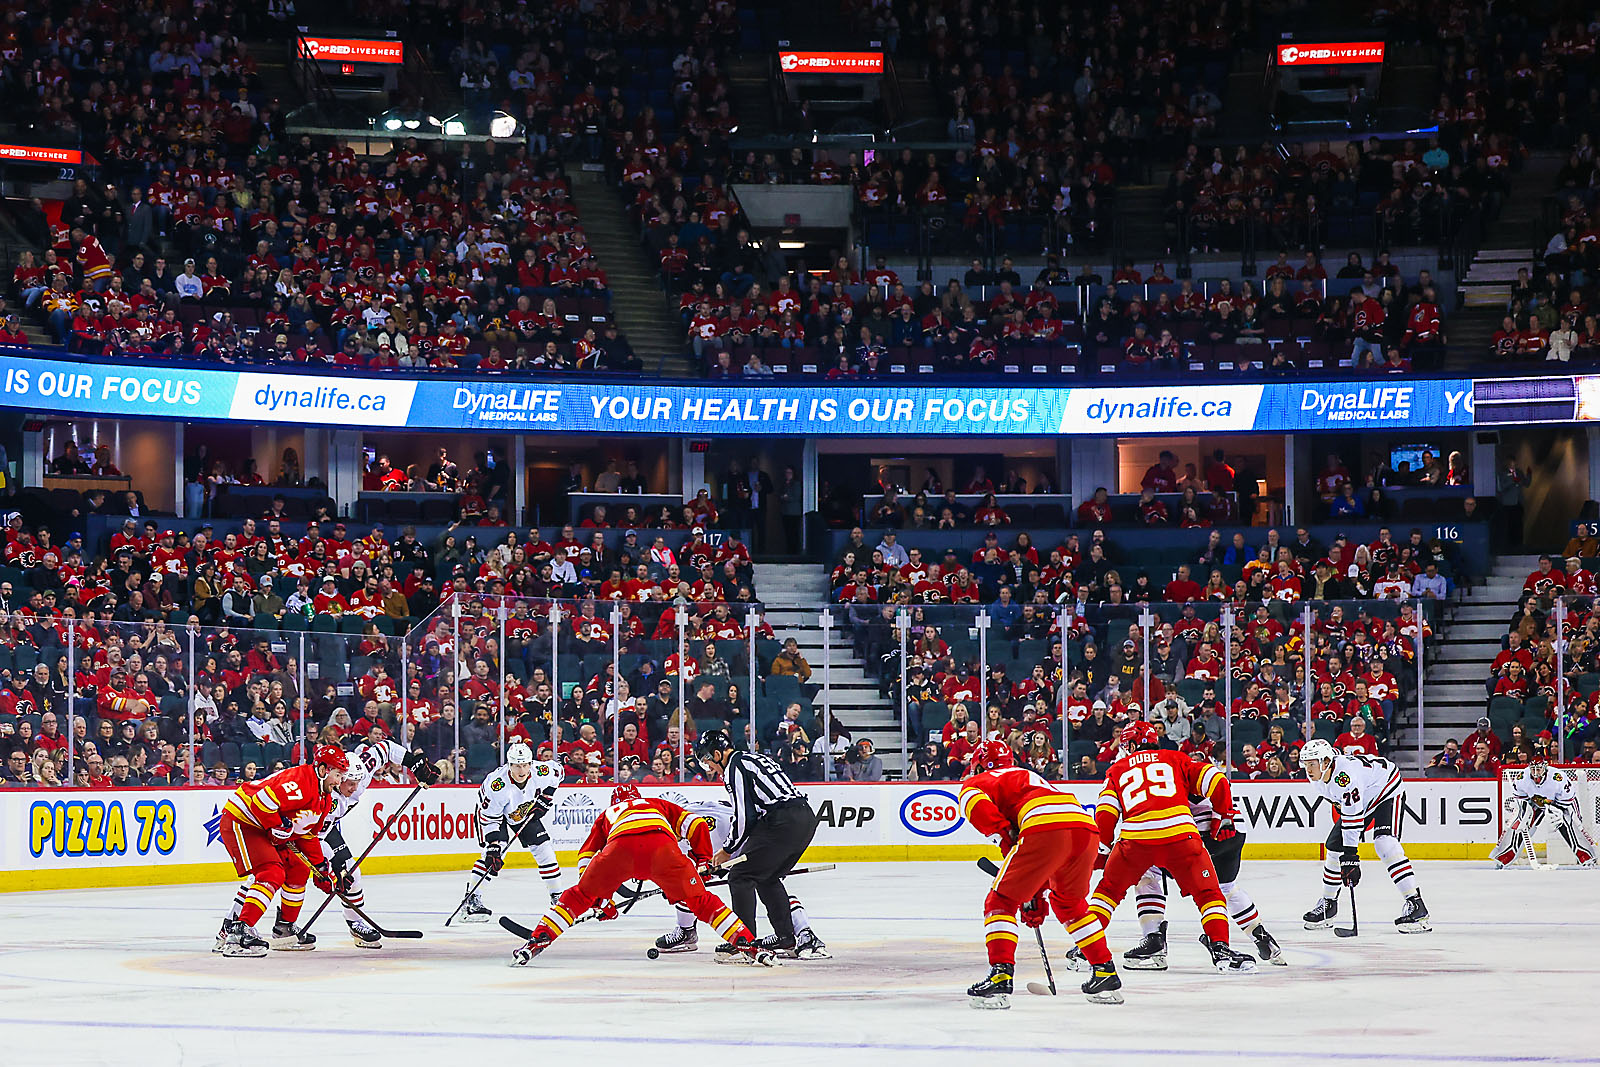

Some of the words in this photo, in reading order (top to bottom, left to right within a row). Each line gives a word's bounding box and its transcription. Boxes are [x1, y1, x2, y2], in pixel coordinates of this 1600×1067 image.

[330, 45, 350, 54] RED
[377, 48, 400, 56] HERE
[1310, 50, 1331, 58] RED
[1358, 48, 1382, 56] HERE
[809, 58, 830, 66] RED
[60, 167, 75, 180] 22
[5, 368, 30, 394] IS
[38, 371, 93, 398] OUR
[101, 376, 202, 405] FOCUS
[255, 384, 386, 411] dynalife.ca
[453, 388, 562, 415] DynaLIFE
[1301, 387, 1413, 415] DynaLIFE
[479, 411, 527, 421] MEDICAL
[529, 412, 558, 422] LABS
[591, 396, 672, 420] YOUR
[682, 398, 799, 421] HEALTH
[808, 398, 837, 421] IS
[848, 398, 914, 422] OUR
[924, 398, 1029, 422] FOCUS
[1086, 396, 1232, 423] dynalife.ca
[1328, 411, 1378, 421] MEDICAL
[1380, 410, 1410, 420] LABS
[703, 533, 722, 546] 117
[1436, 526, 1459, 540] 116
[1122, 665, 1135, 675] CAT
[1128, 752, 1160, 768] DUBE
[282, 781, 304, 801] 27
[1118, 762, 1177, 813] 29
[910, 802, 957, 821] Esso
[31, 800, 127, 857] PIZZA
[134, 799, 177, 856] 73
